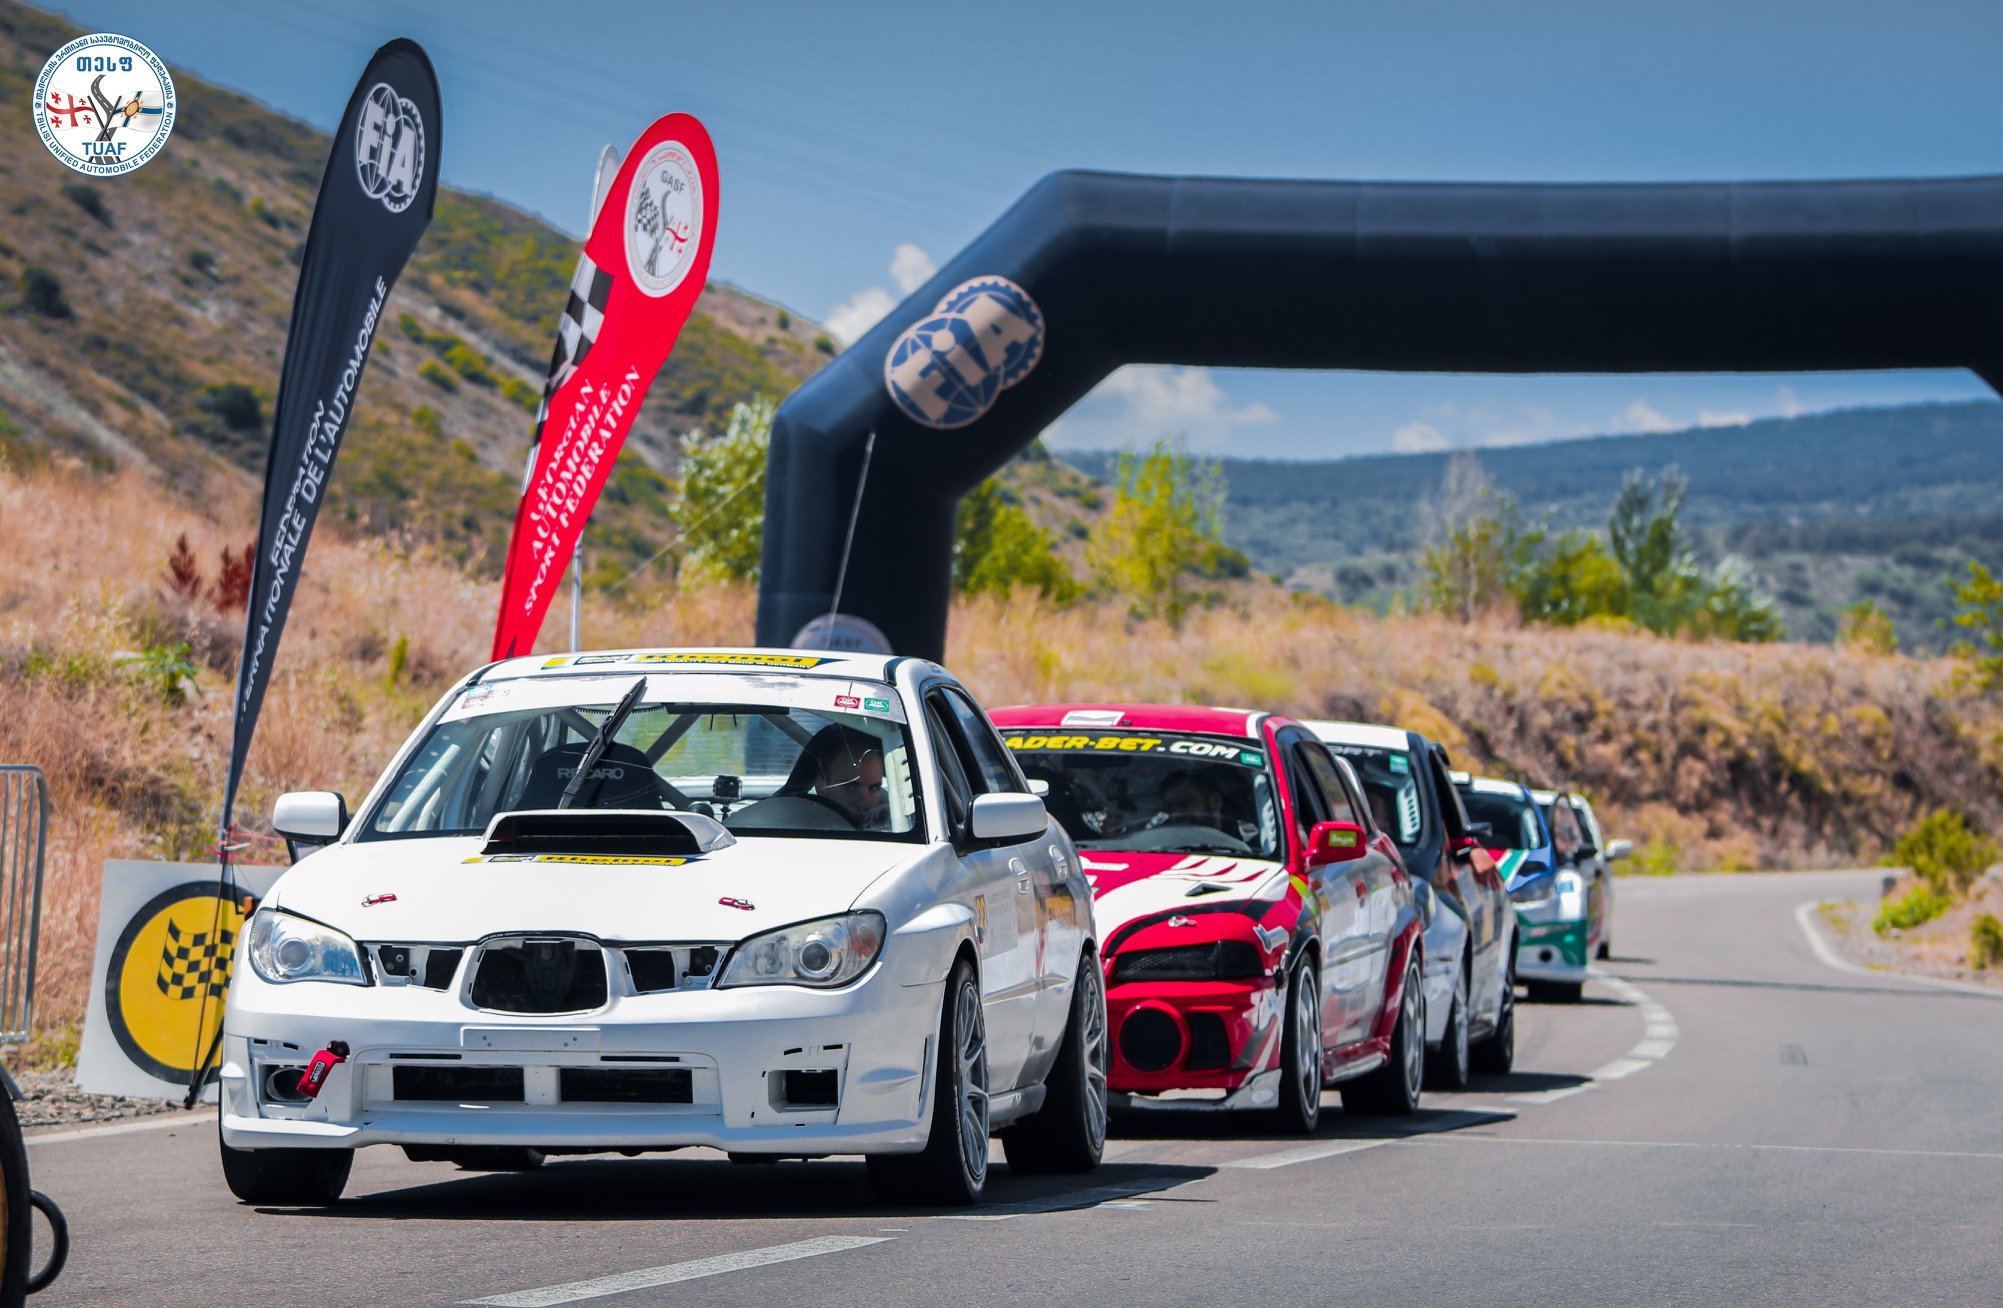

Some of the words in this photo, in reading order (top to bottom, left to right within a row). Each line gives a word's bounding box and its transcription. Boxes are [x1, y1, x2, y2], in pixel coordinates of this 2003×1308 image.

[359, 99, 415, 197] FIA
[660, 169, 687, 195] GASF
[301, 461, 325, 504] DE
[314, 275, 388, 465] L'AUTOMOBILE
[891, 293, 1037, 422] FIA
[524, 527, 561, 617] SPORT
[559, 365, 641, 529] FEDERATION
[532, 382, 612, 560] AUTOMOBILE
[1004, 735, 1240, 760] ADER-BET.COM
